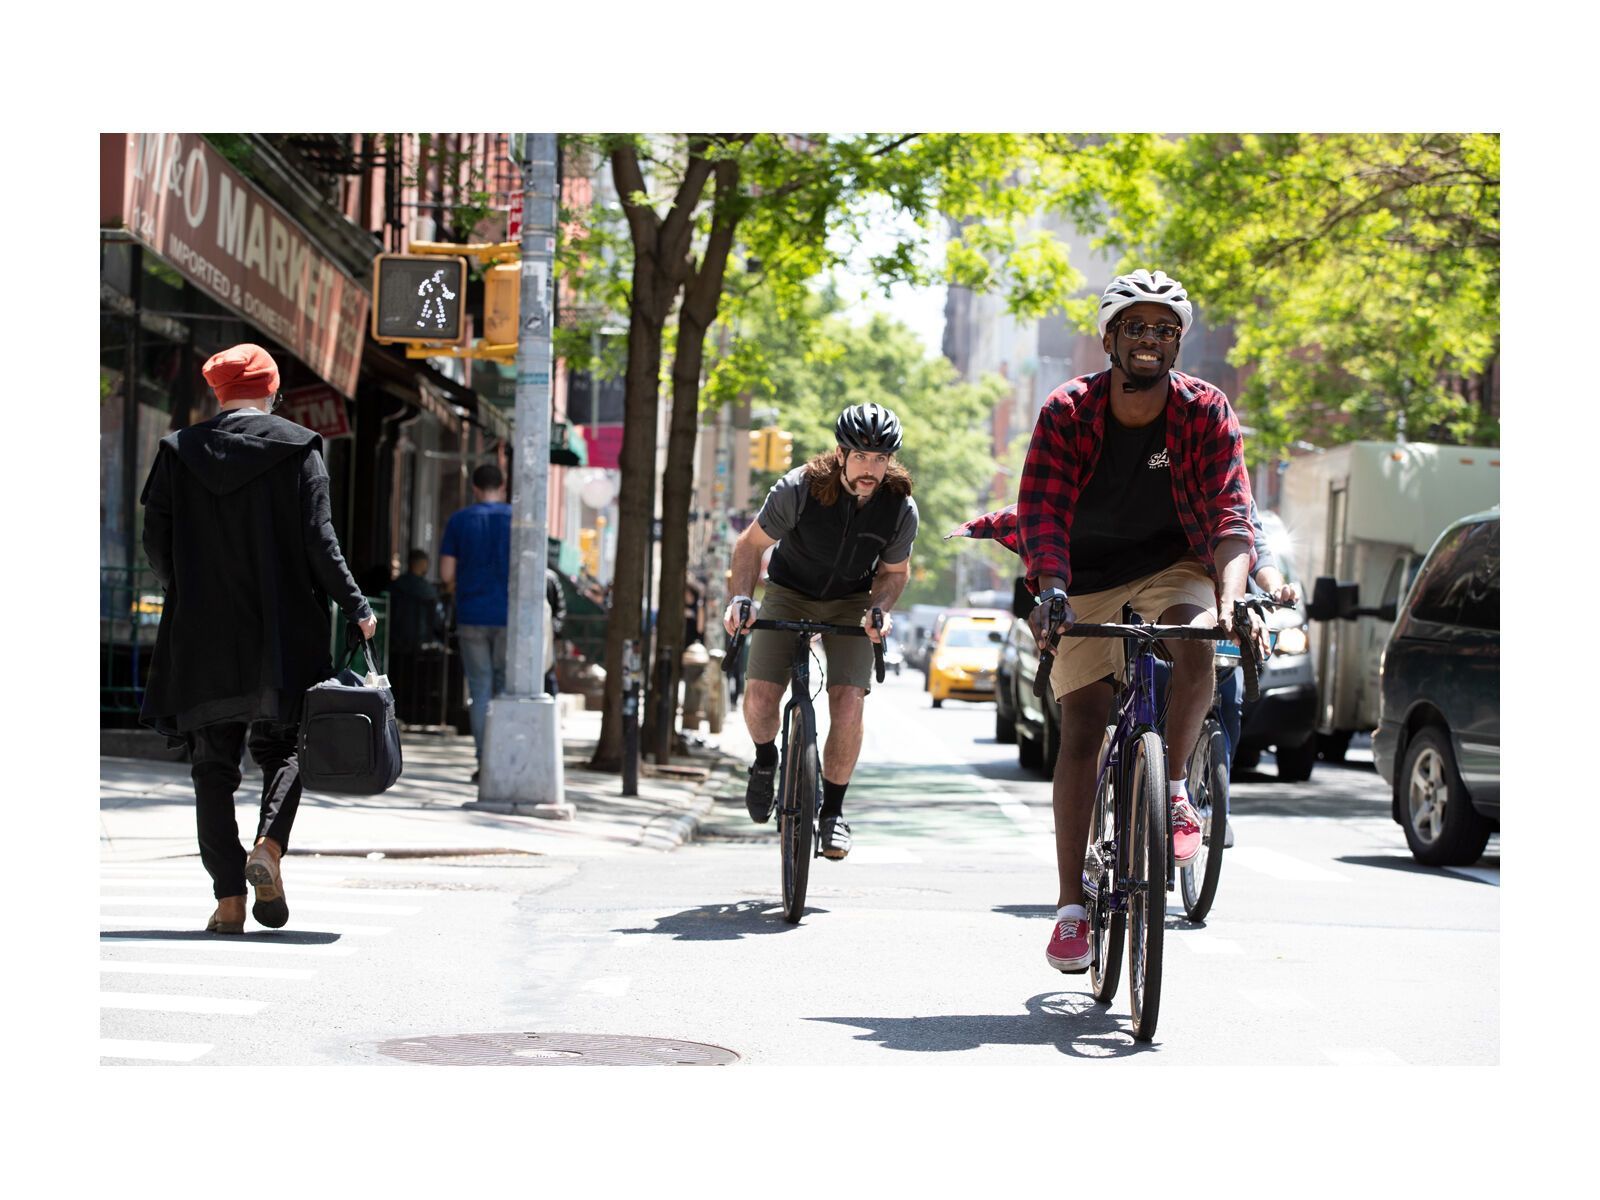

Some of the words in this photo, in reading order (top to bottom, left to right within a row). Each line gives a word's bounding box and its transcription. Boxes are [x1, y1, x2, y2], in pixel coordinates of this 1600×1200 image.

[169, 233, 230, 297] IMPORTED
[232, 283, 243, 307] &
[216, 172, 333, 329] MARKET
[289, 399, 339, 429] TM
